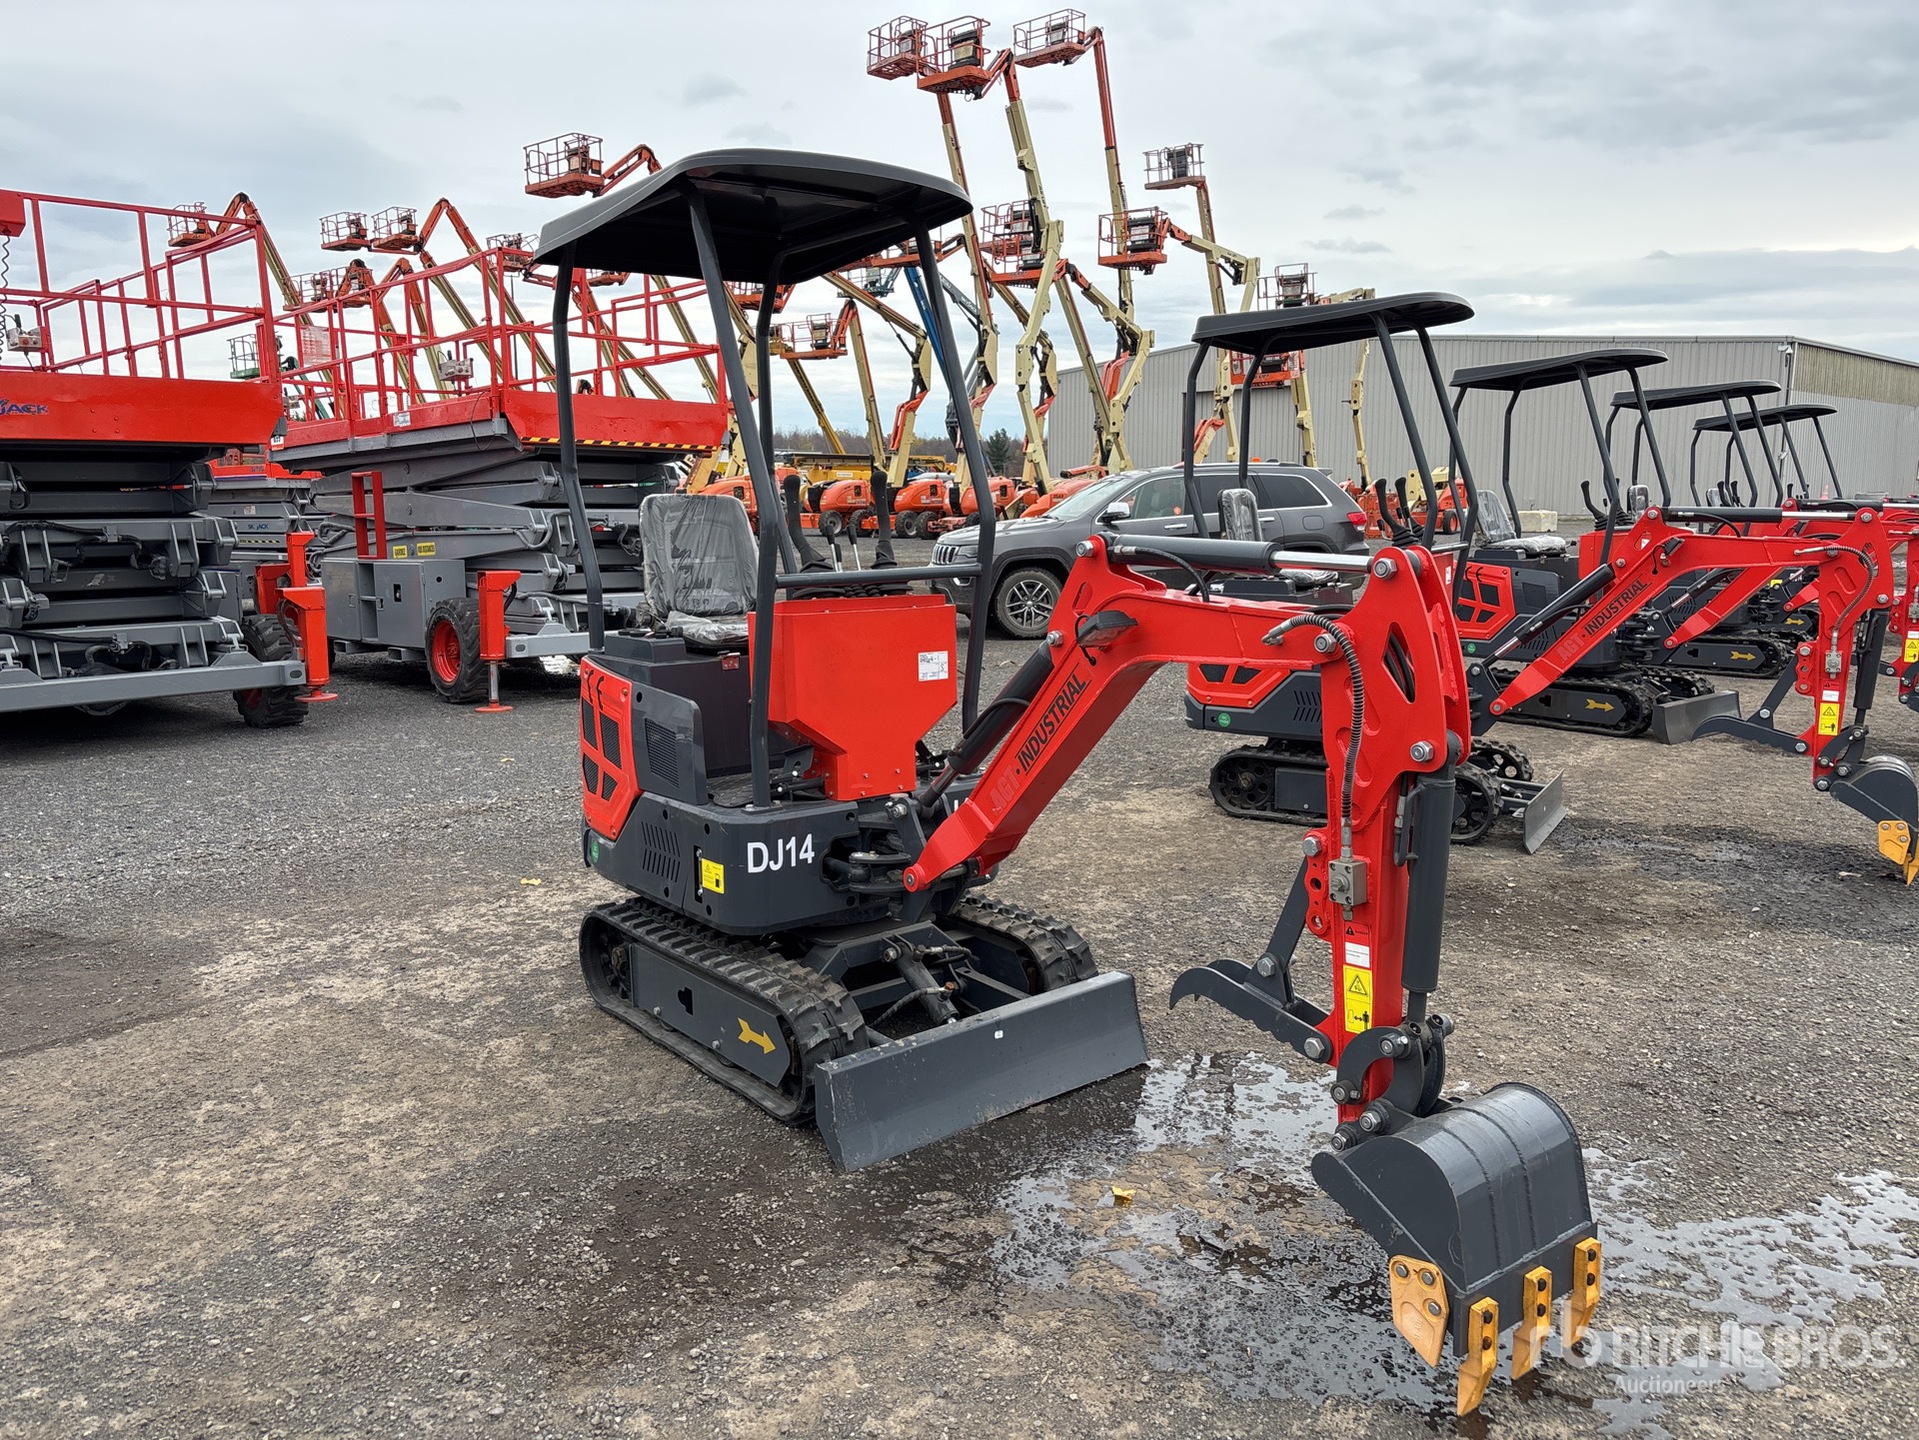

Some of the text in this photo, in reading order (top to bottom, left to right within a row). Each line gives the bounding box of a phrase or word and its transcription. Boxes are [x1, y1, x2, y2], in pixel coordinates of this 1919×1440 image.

[1556, 579, 1648, 663] AGT INDUSTRIAL
[989, 672, 1087, 817] AGT INDUSTRIAL
[747, 833, 815, 873] DJ14
